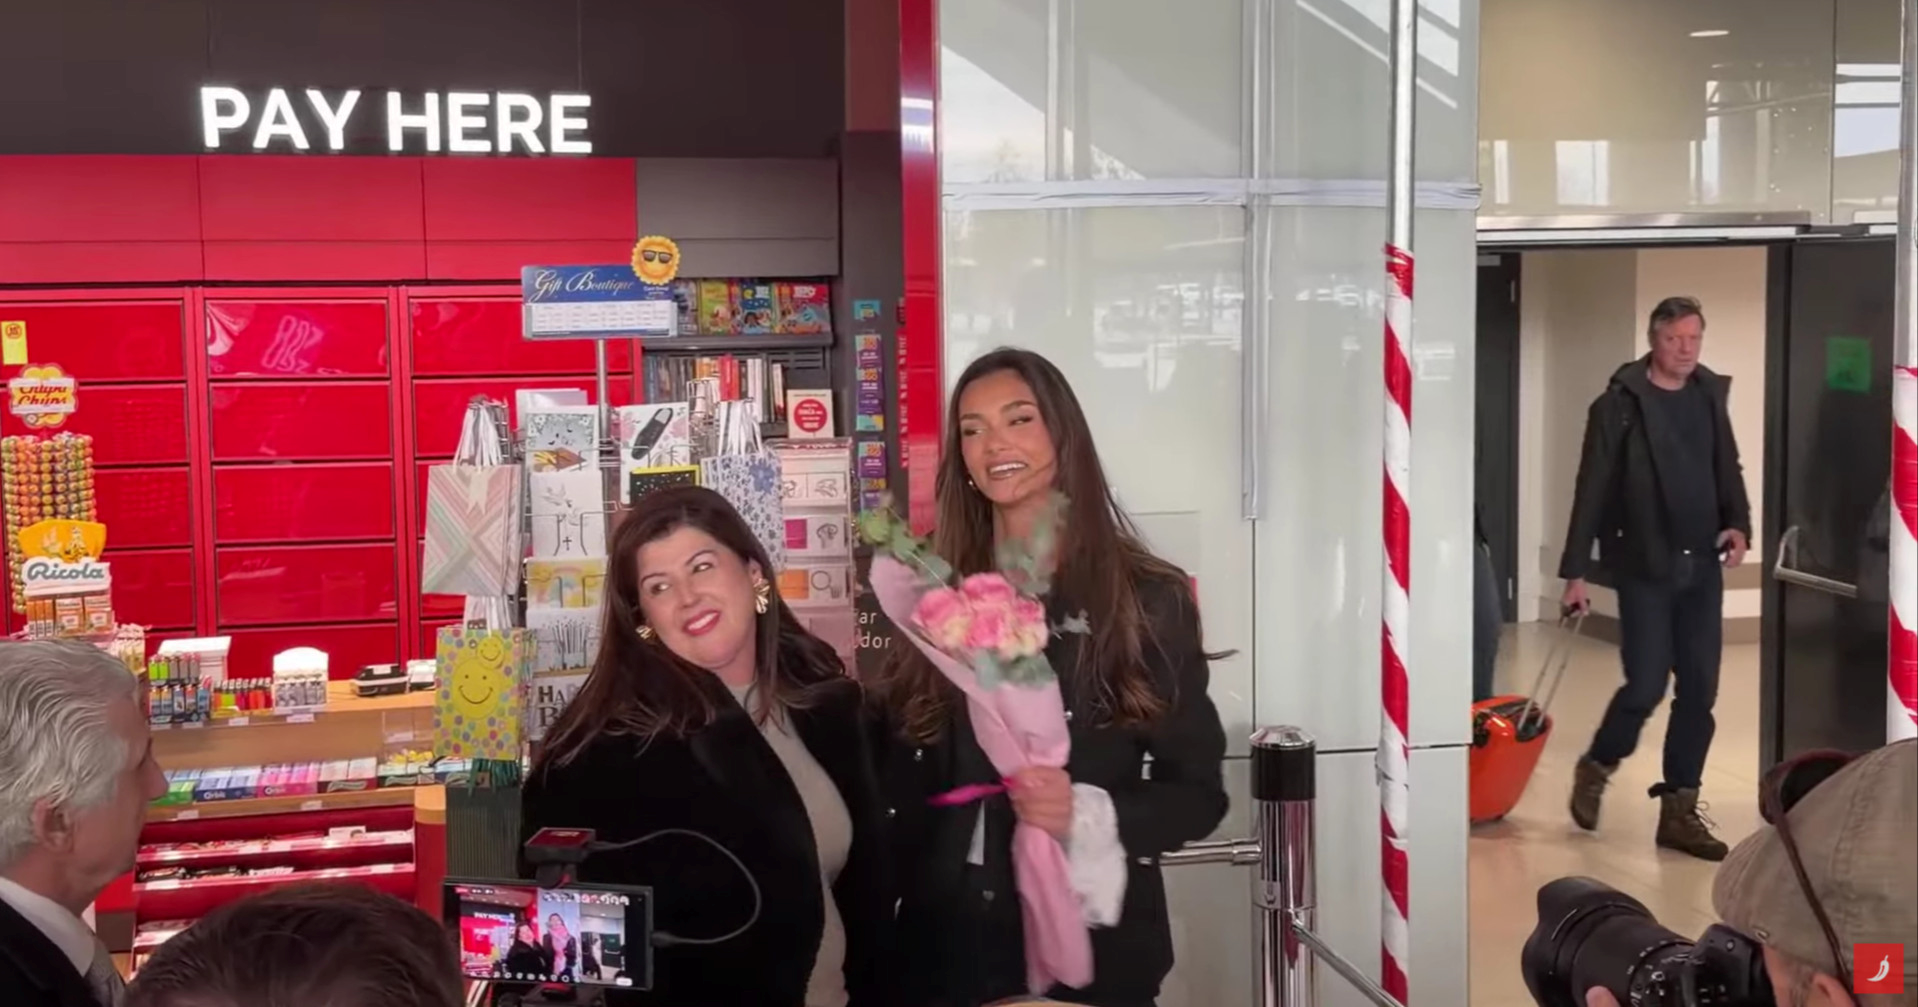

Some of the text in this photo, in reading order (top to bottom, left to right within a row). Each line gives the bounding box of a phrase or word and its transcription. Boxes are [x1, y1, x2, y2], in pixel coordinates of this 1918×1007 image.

[200, 86, 592, 153] PAY HERE
[530, 268, 633, 302] Gift Boutique
[27, 562, 104, 580] Ricola
